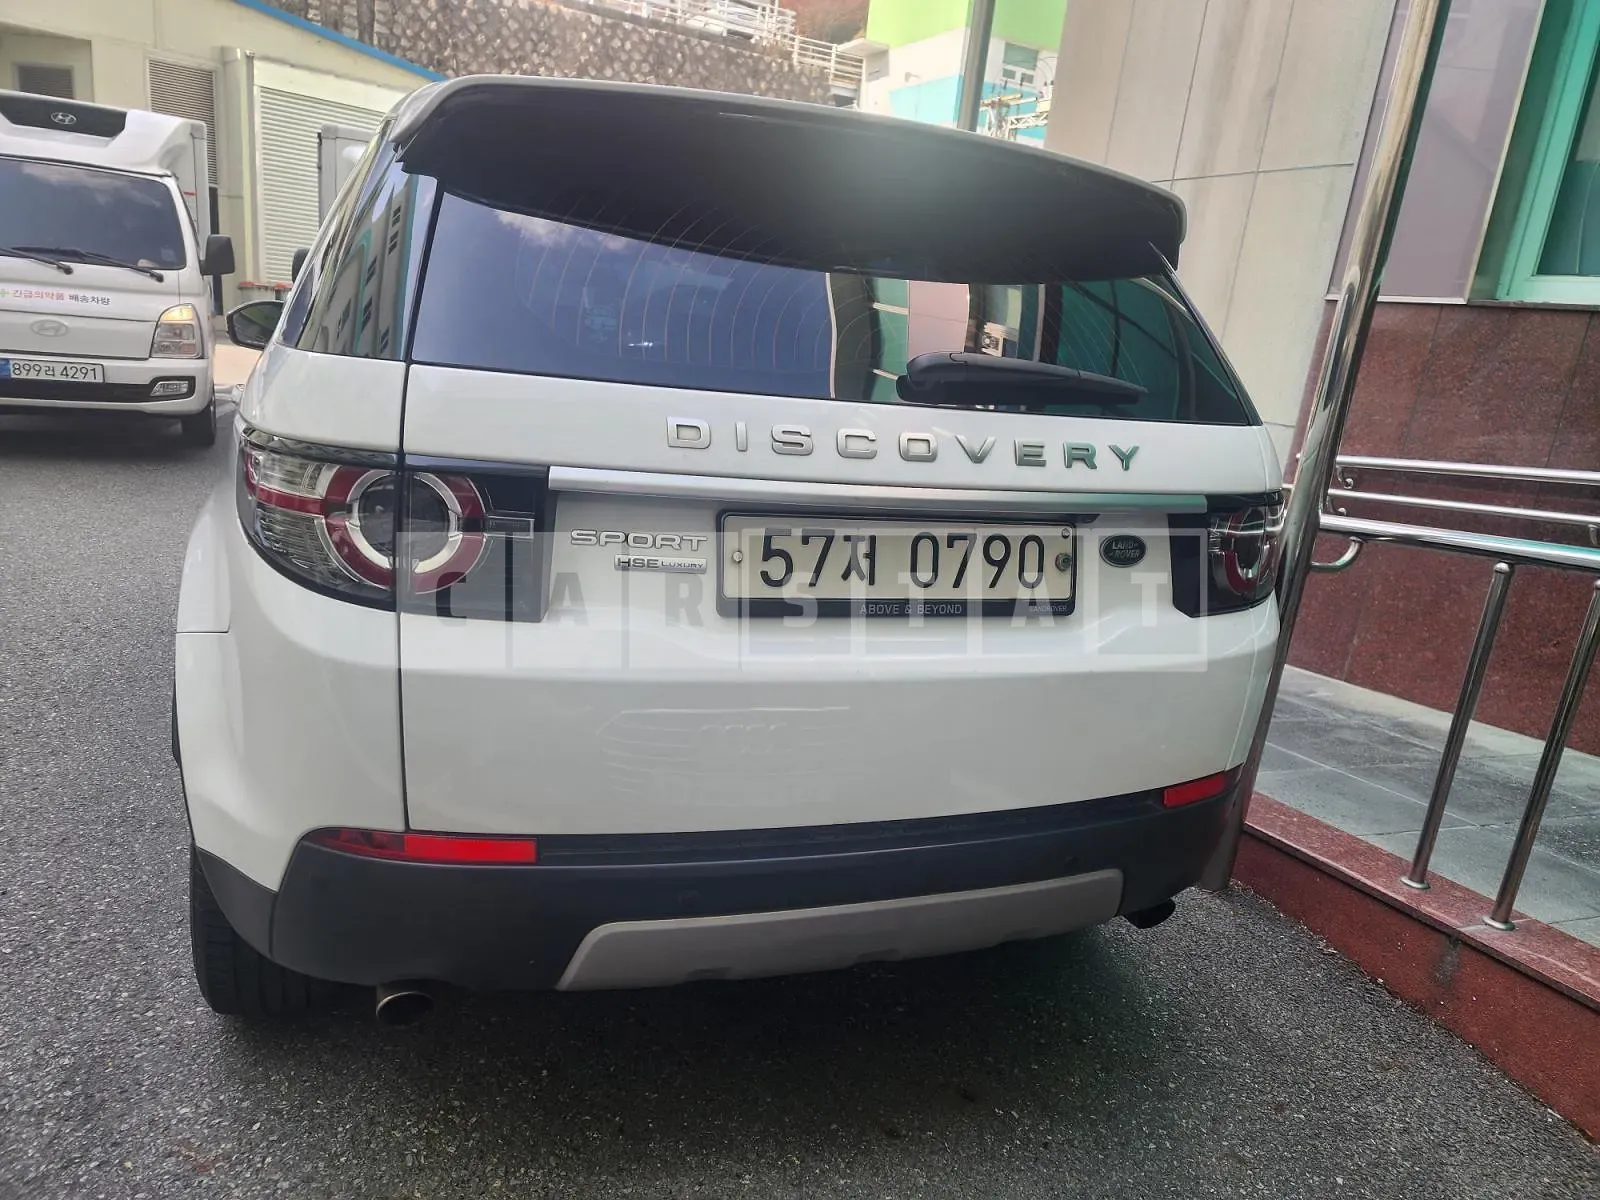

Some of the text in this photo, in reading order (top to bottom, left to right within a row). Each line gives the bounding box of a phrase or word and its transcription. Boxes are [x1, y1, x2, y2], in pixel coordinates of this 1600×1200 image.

[68, 294, 111, 305] 배송차량
[60, 366, 97, 380] 4291
[666, 416, 1140, 471] DISCOVERY
[570, 529, 708, 551] SPORT
[1112, 540, 1134, 550] LAND
[759, 528, 1046, 589] 57저 0790
[1115, 549, 1140, 558] ROVER
[616, 557, 704, 569] HSE LUXURY
[860, 604, 962, 614] ABOVE & BEYOND
